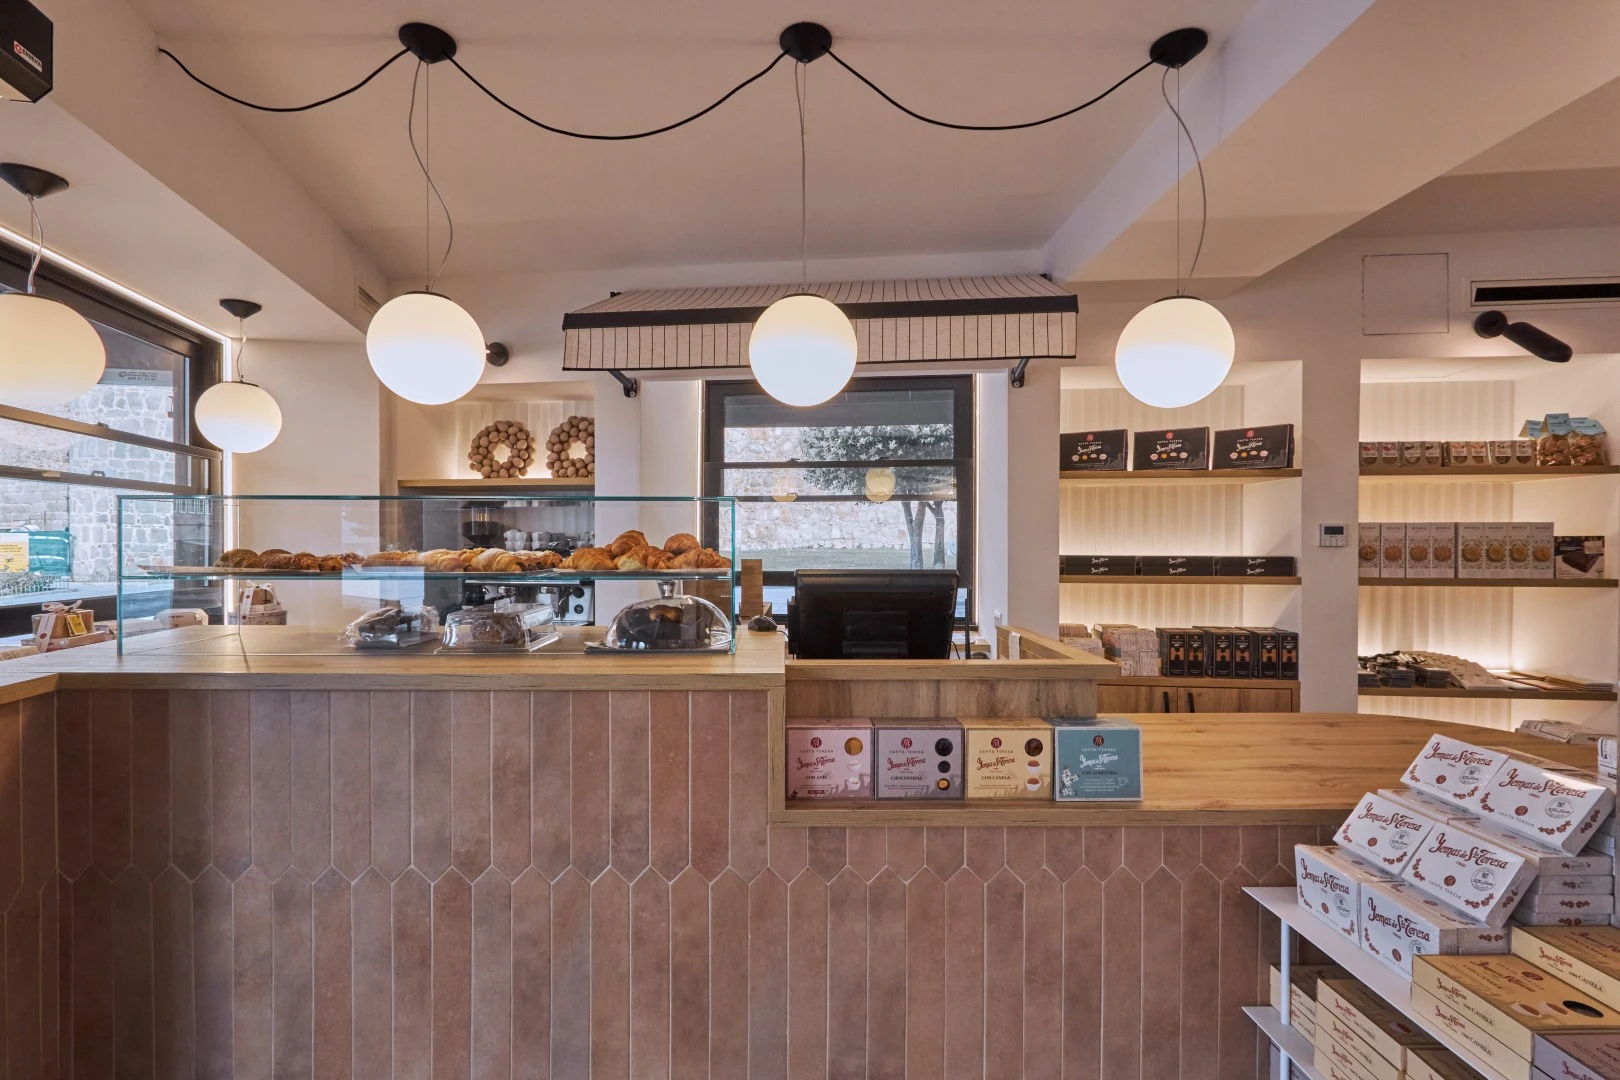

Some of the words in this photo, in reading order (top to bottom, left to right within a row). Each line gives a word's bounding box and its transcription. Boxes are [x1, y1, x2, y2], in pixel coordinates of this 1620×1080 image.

[1425, 742, 1453, 761] Yemas
[1464, 752, 1493, 766] Teresa
[1499, 768, 1534, 790] Yemas
[1550, 780, 1588, 798] Teresa
[1358, 802, 1384, 822] Yemas
[1395, 815, 1422, 831] Teresa
[1429, 832, 1460, 858] Yemas
[1475, 849, 1509, 869] Teresa
[1301, 858, 1320, 883] Yemas
[1368, 897, 1392, 927] Yemas
[1404, 918, 1431, 942] Teresa
